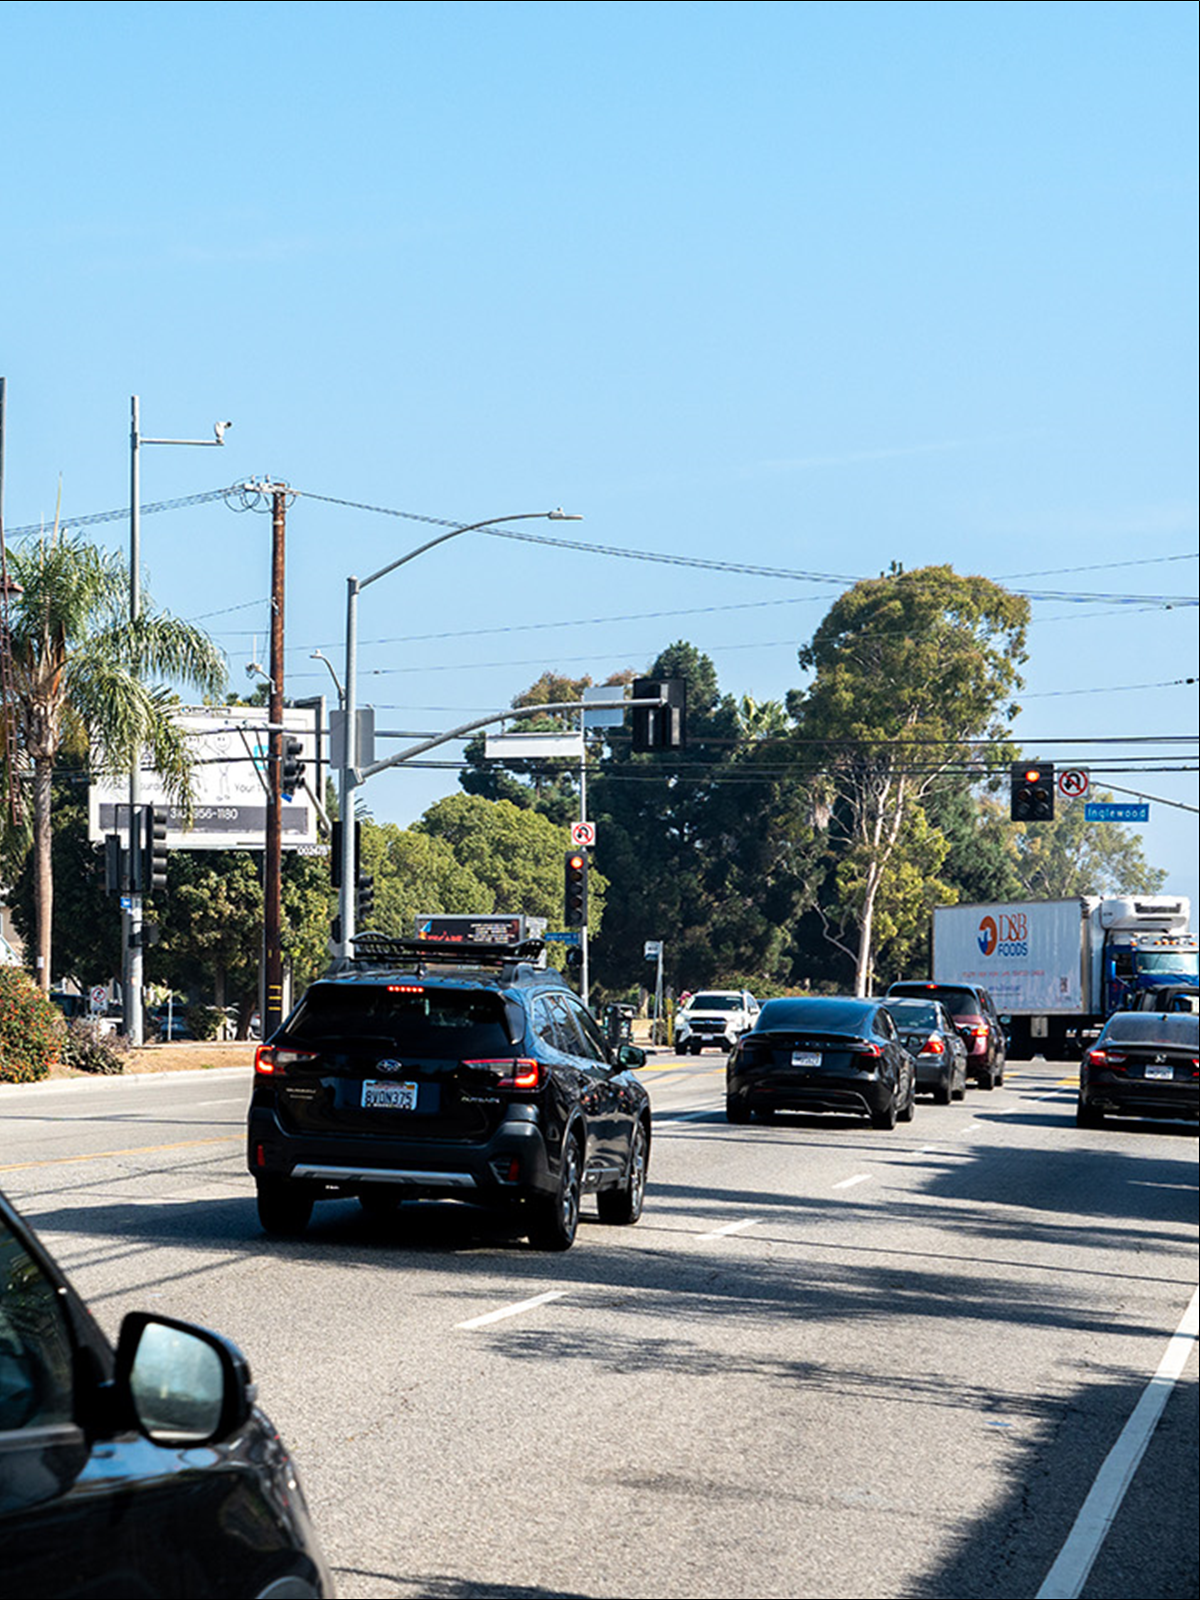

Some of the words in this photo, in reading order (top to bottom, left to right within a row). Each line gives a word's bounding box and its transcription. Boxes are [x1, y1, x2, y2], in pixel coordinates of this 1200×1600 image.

[1088, 807, 1146, 819] Inglewood
[998, 913, 1028, 942] D&B
[997, 942, 1029, 957] FOODS
